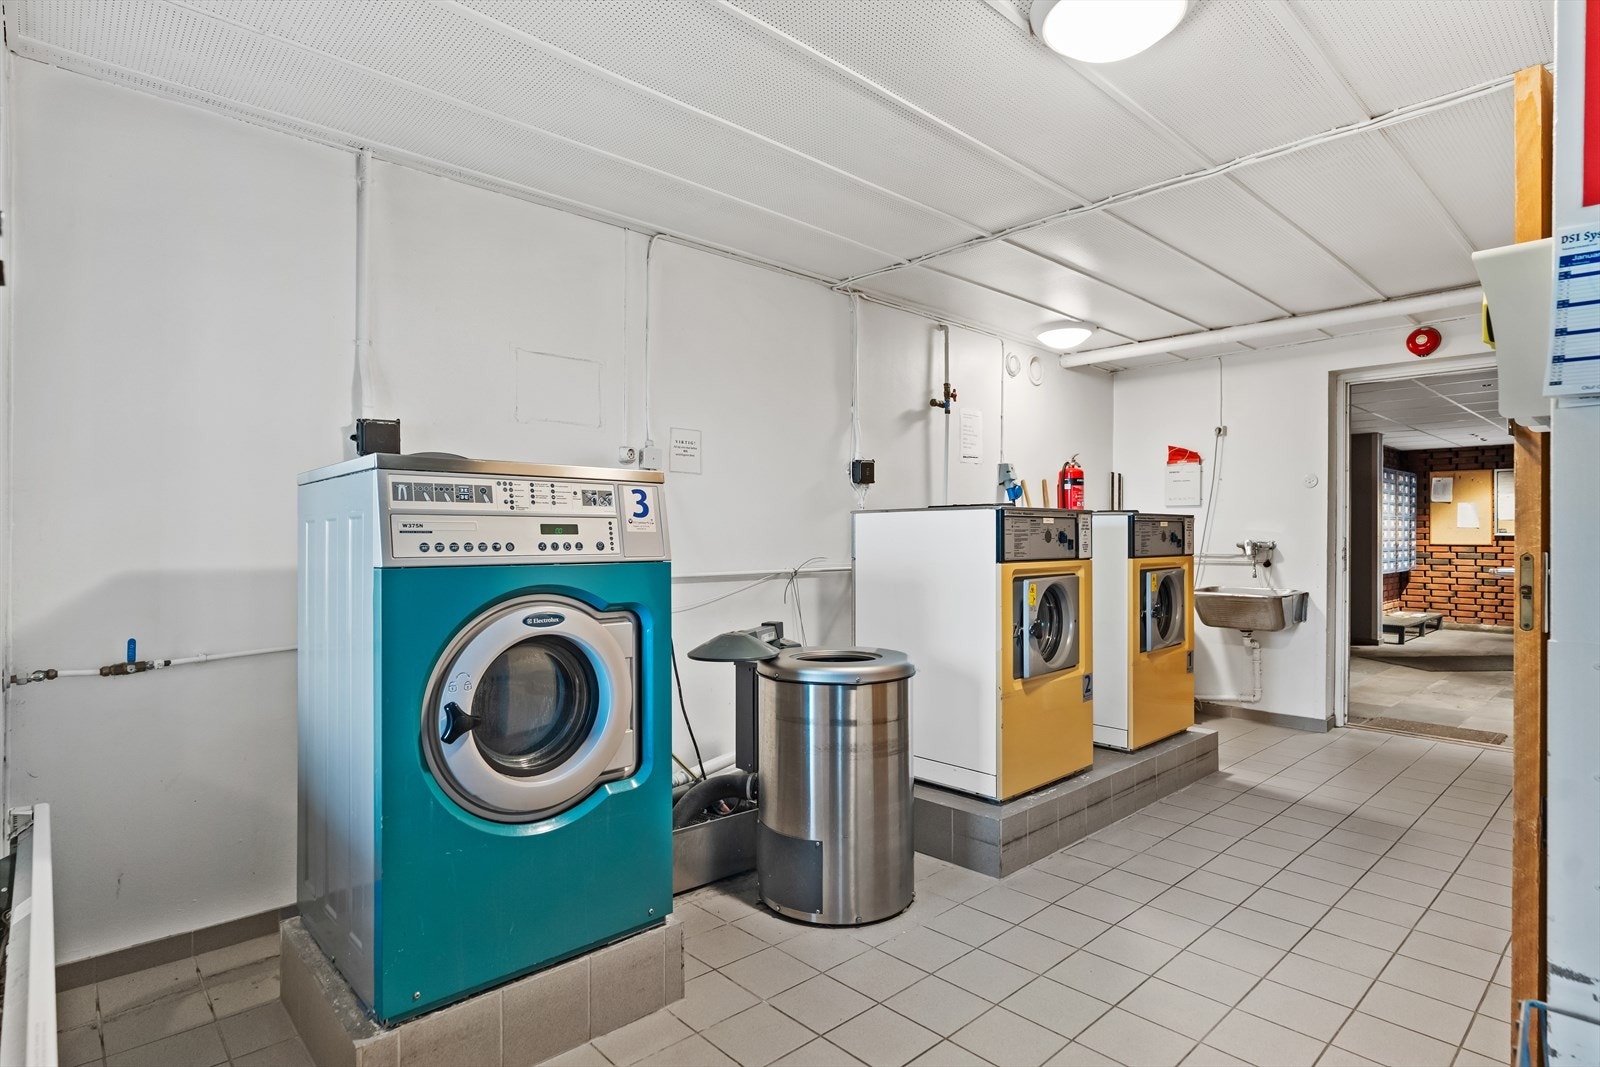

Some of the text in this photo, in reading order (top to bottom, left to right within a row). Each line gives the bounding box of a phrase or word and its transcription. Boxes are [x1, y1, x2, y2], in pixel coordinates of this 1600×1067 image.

[1561, 233, 1580, 244] DSI
[631, 488, 650, 518] 3
[1084, 675, 1091, 693] 2
